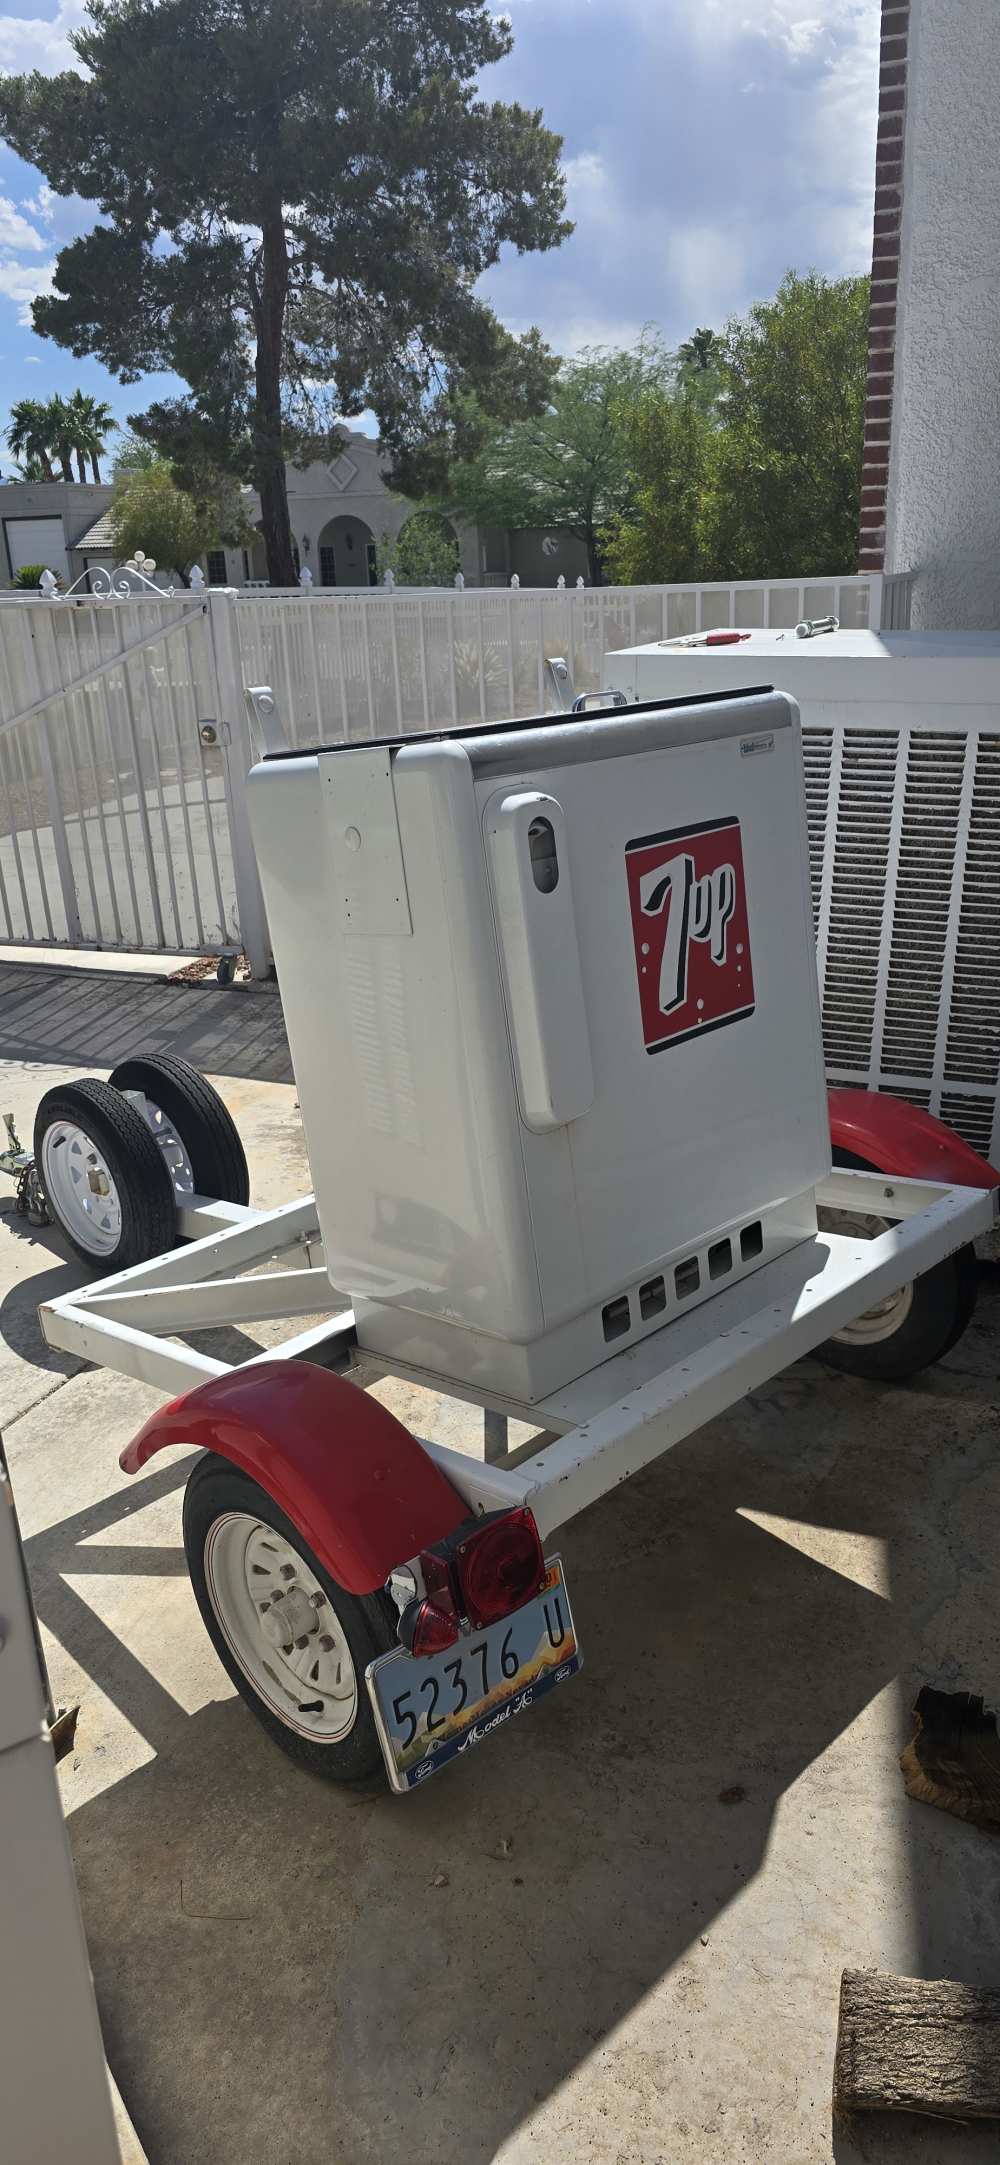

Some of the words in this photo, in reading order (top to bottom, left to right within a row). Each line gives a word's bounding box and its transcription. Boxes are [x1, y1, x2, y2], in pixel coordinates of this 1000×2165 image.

[392, 1627, 519, 1750] 52376
[543, 1598, 565, 1648] U
[457, 1705, 511, 1751] Model
